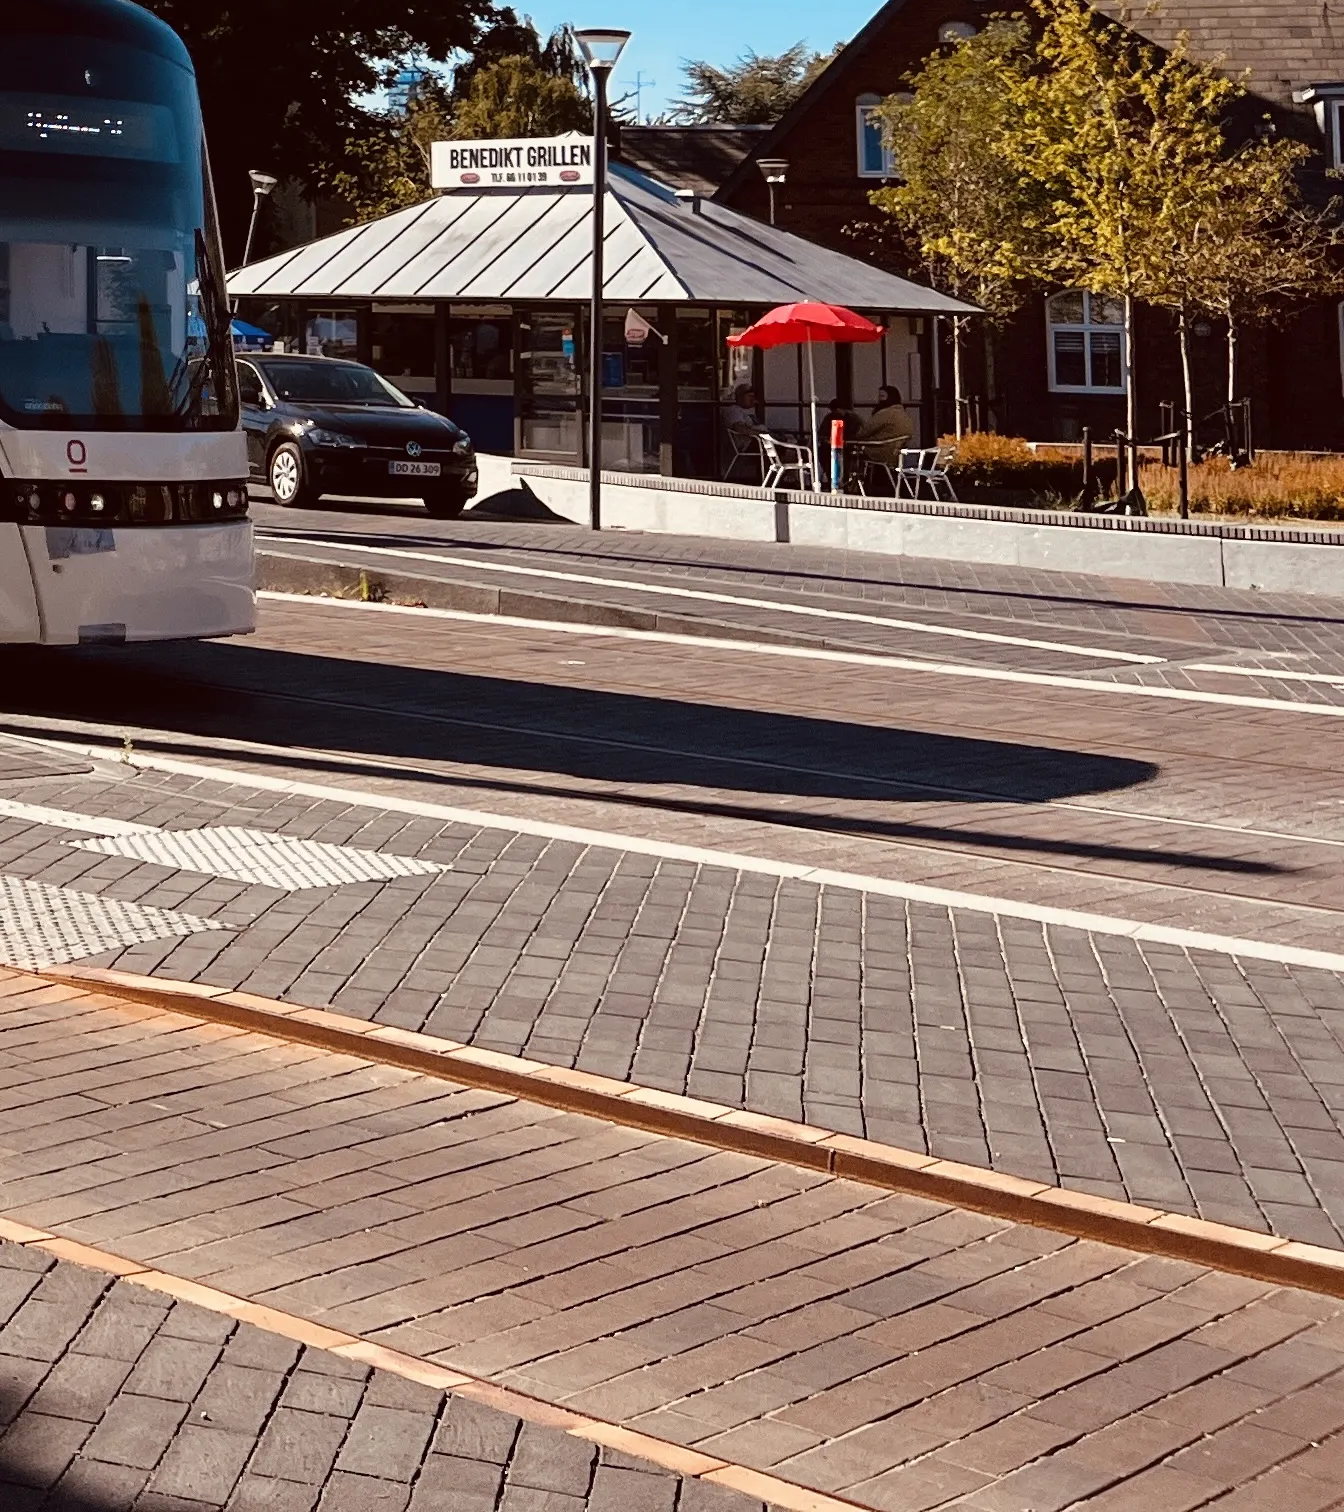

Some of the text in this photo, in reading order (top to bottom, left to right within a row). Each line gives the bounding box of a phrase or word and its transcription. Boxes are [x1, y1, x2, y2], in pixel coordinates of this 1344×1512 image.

[450, 145, 591, 169] BENEDIKT GRILLEN
[491, 172, 505, 183] TLF.
